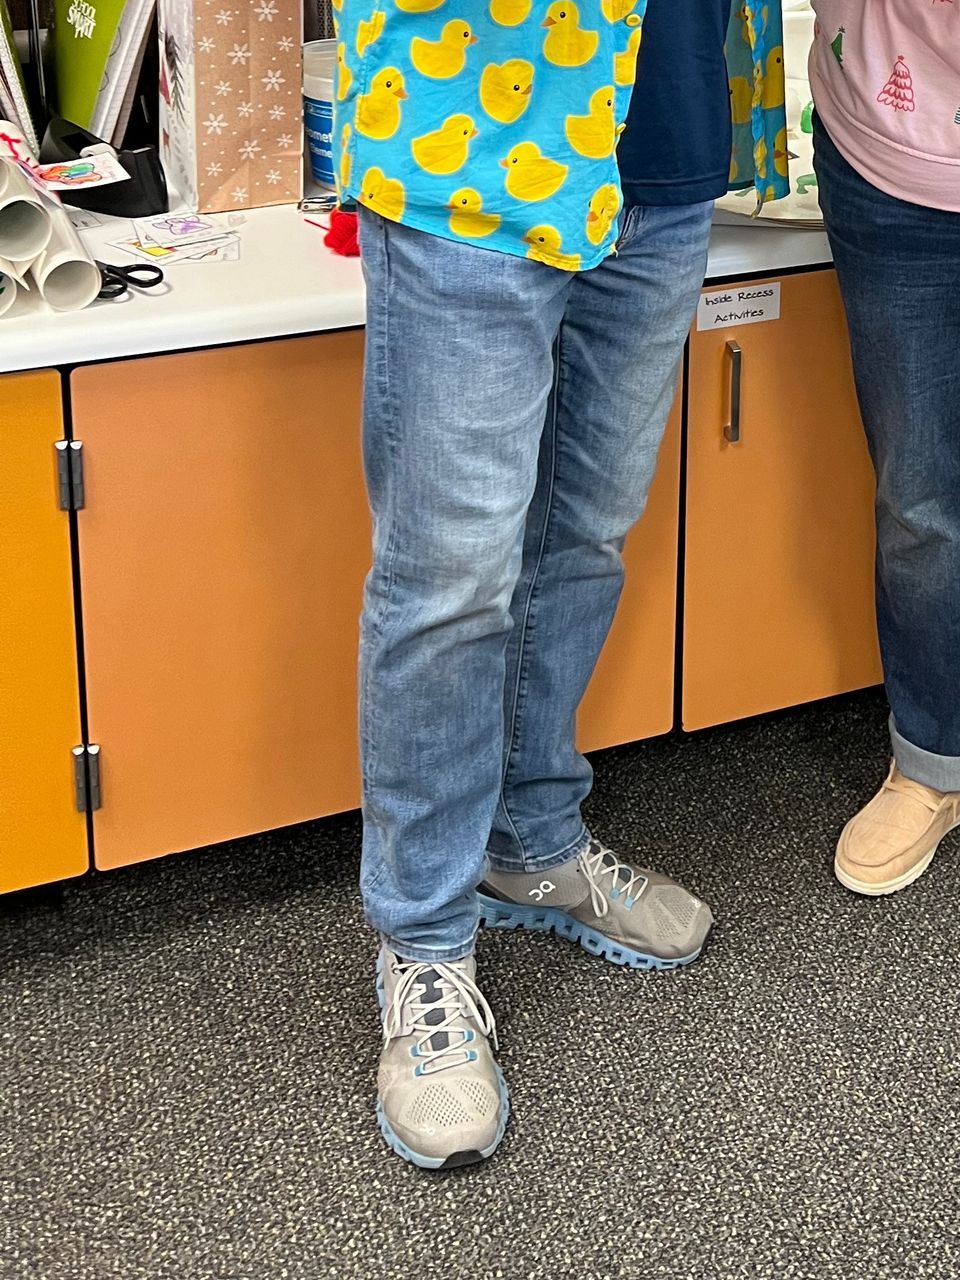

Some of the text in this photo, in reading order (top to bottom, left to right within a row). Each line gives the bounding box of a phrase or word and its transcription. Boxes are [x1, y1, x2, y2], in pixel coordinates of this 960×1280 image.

[66, 6, 97, 39] SMART
[705, 288, 775, 306] Inside Recess
[713, 309, 764, 324] Activities
